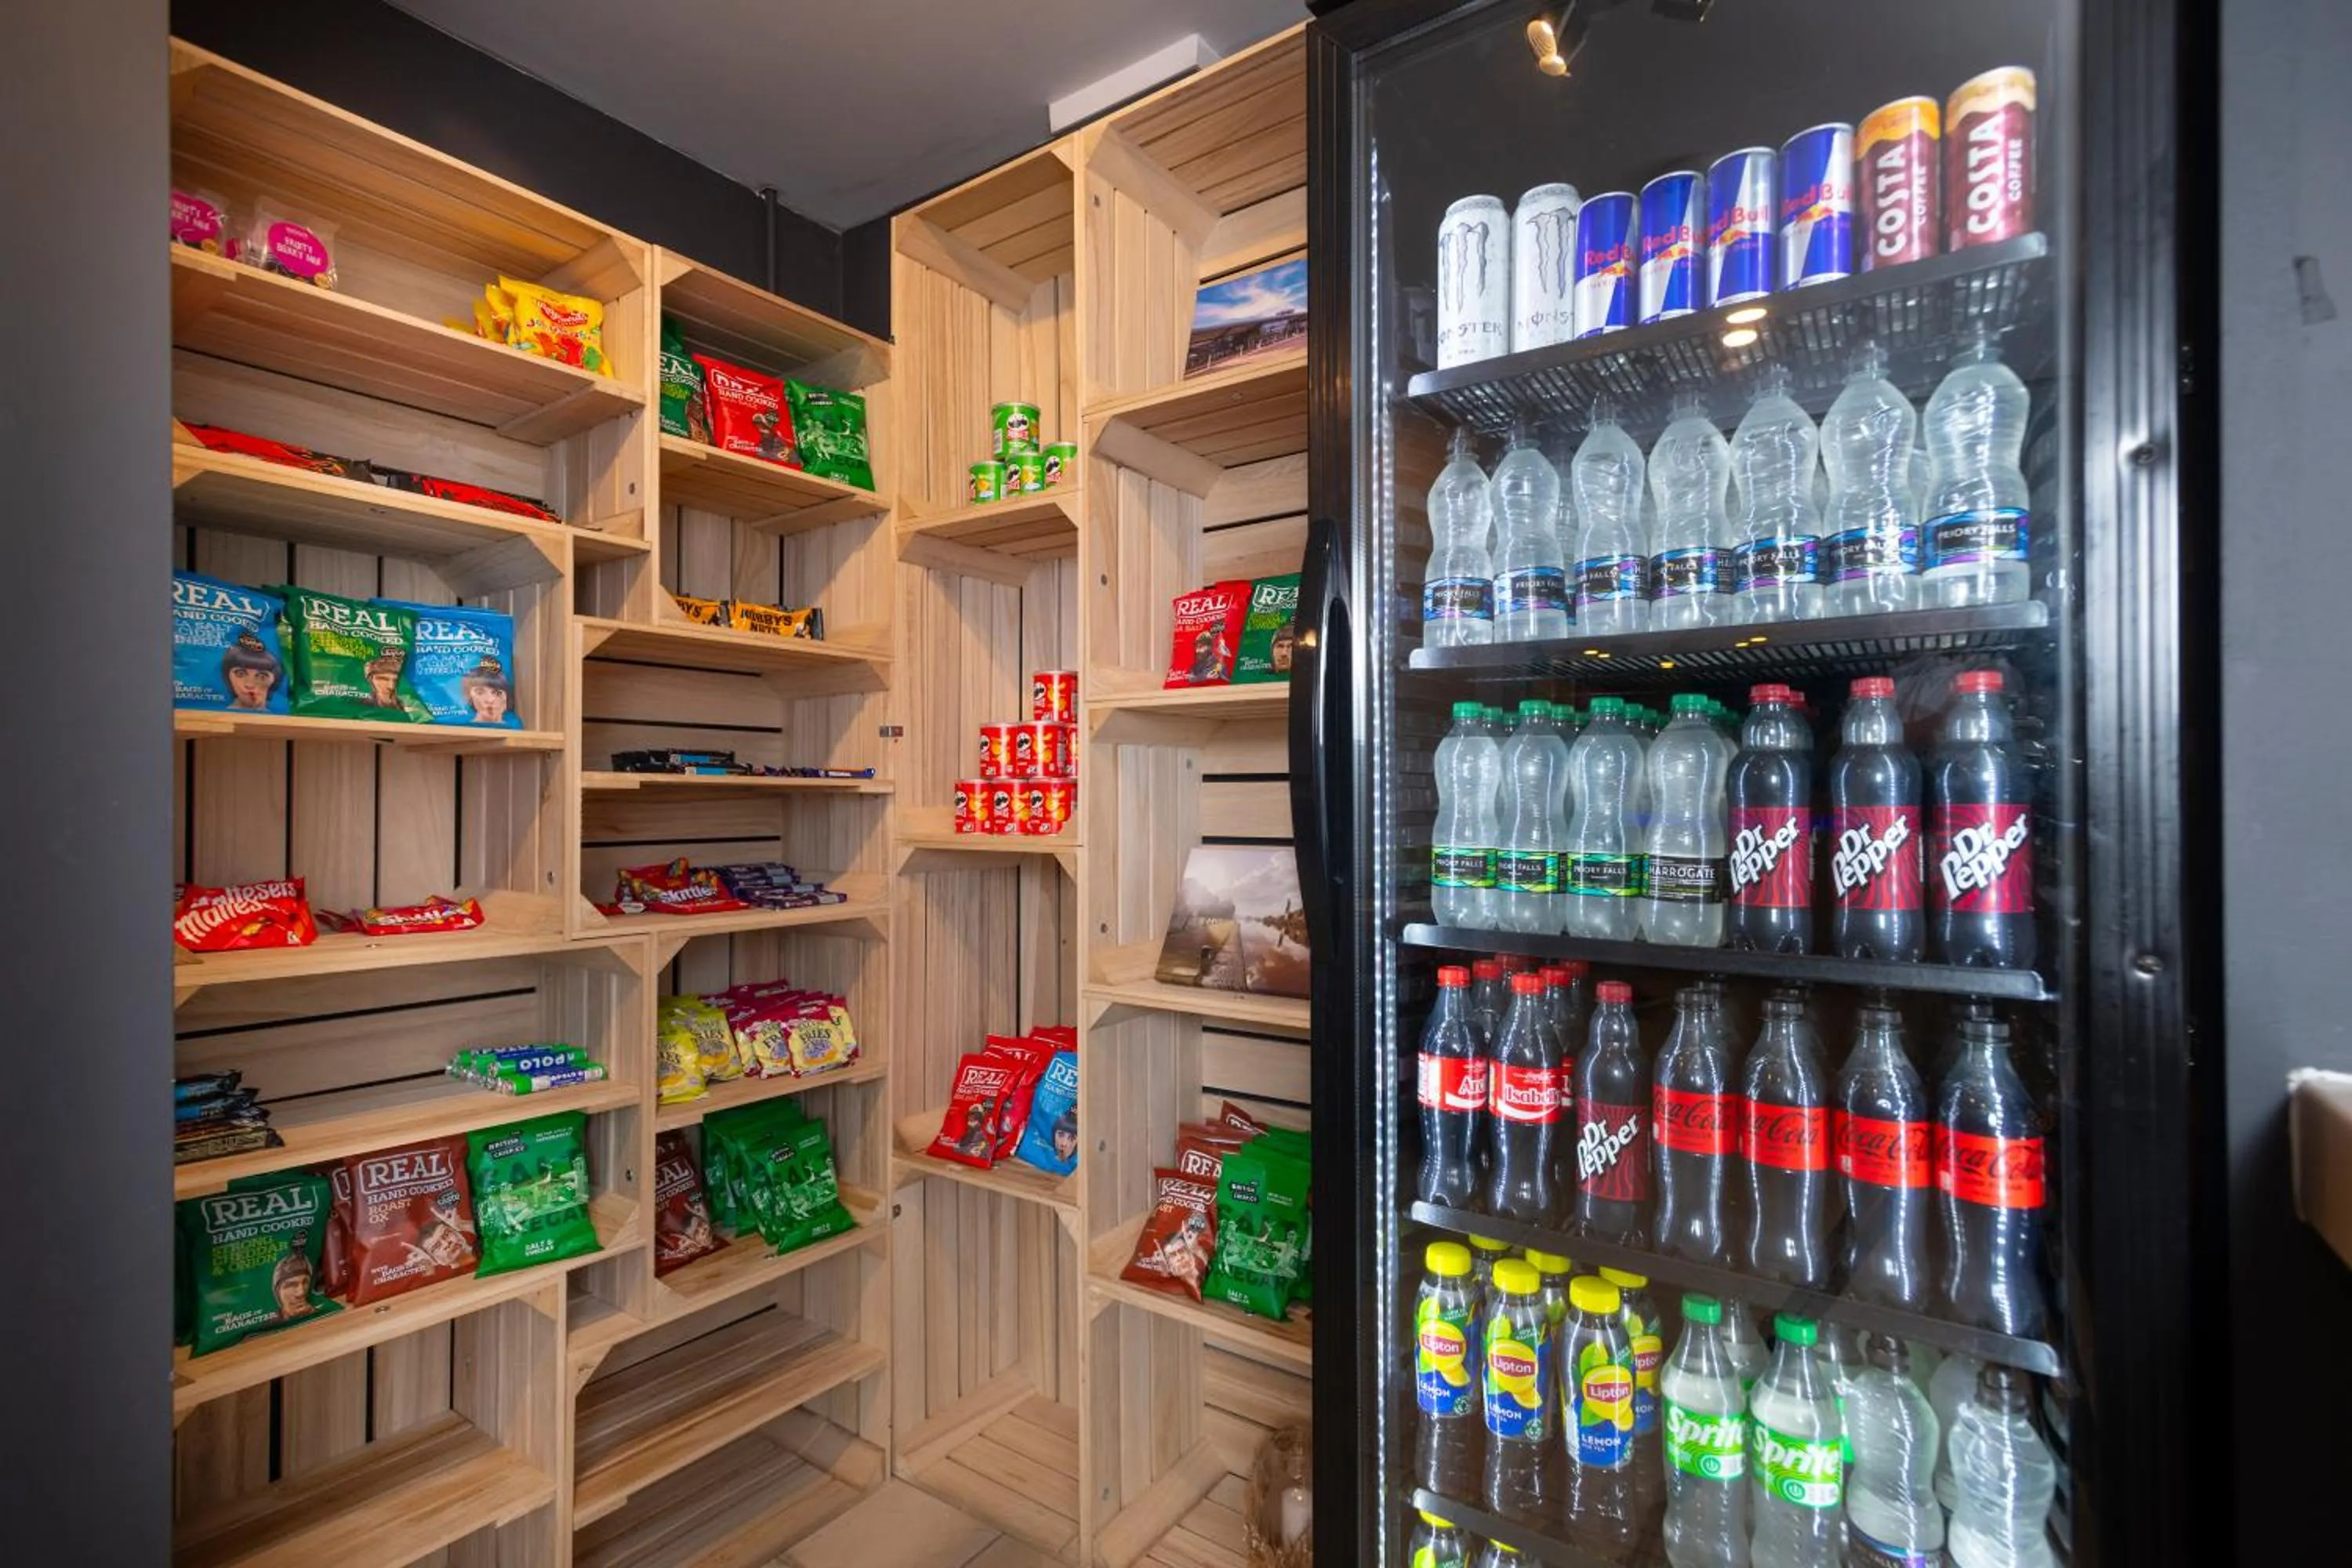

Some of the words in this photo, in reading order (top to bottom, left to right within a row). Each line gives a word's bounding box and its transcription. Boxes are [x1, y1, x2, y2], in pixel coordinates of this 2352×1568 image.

[1967, 112, 2005, 234] COSTA
[1877, 144, 1910, 256] COSTA
[1586, 242, 1618, 266] Red
[173, 609, 206, 622] AND
[311, 599, 397, 631] REAL
[1177, 595, 1227, 615] REAL
[1730, 816, 1800, 894] Pepper
[1736, 825, 1764, 860] Dr
[1838, 824, 1871, 861] Dr
[1953, 822, 1994, 862] Dr
[1832, 815, 1909, 897] Pepper
[1940, 813, 2027, 899] Pepper
[1650, 864, 1715, 879] HARROGATE
[174, 900, 289, 943] Maltes
[520, 1054, 565, 1071] POLO
[1052, 1063, 1077, 1087] RE
[965, 1069, 1004, 1086] REAL
[1577, 1115, 1640, 1179] Pepper
[1583, 1120, 1607, 1148] Dr
[367, 1154, 447, 1188] REAL
[212, 1186, 312, 1225] REAL
[368, 1187, 407, 1204] HAND
[368, 1198, 412, 1215] ROAST
[213, 1227, 258, 1244] HAND
[262, 1217, 314, 1234] COOKED
[369, 1212, 390, 1224] OX
[1425, 1335, 1459, 1352] Lipton
[1497, 1359, 1531, 1373] Lipton
[1590, 1385, 1629, 1400] Lipton
[1581, 1433, 1621, 1446] LEMON
